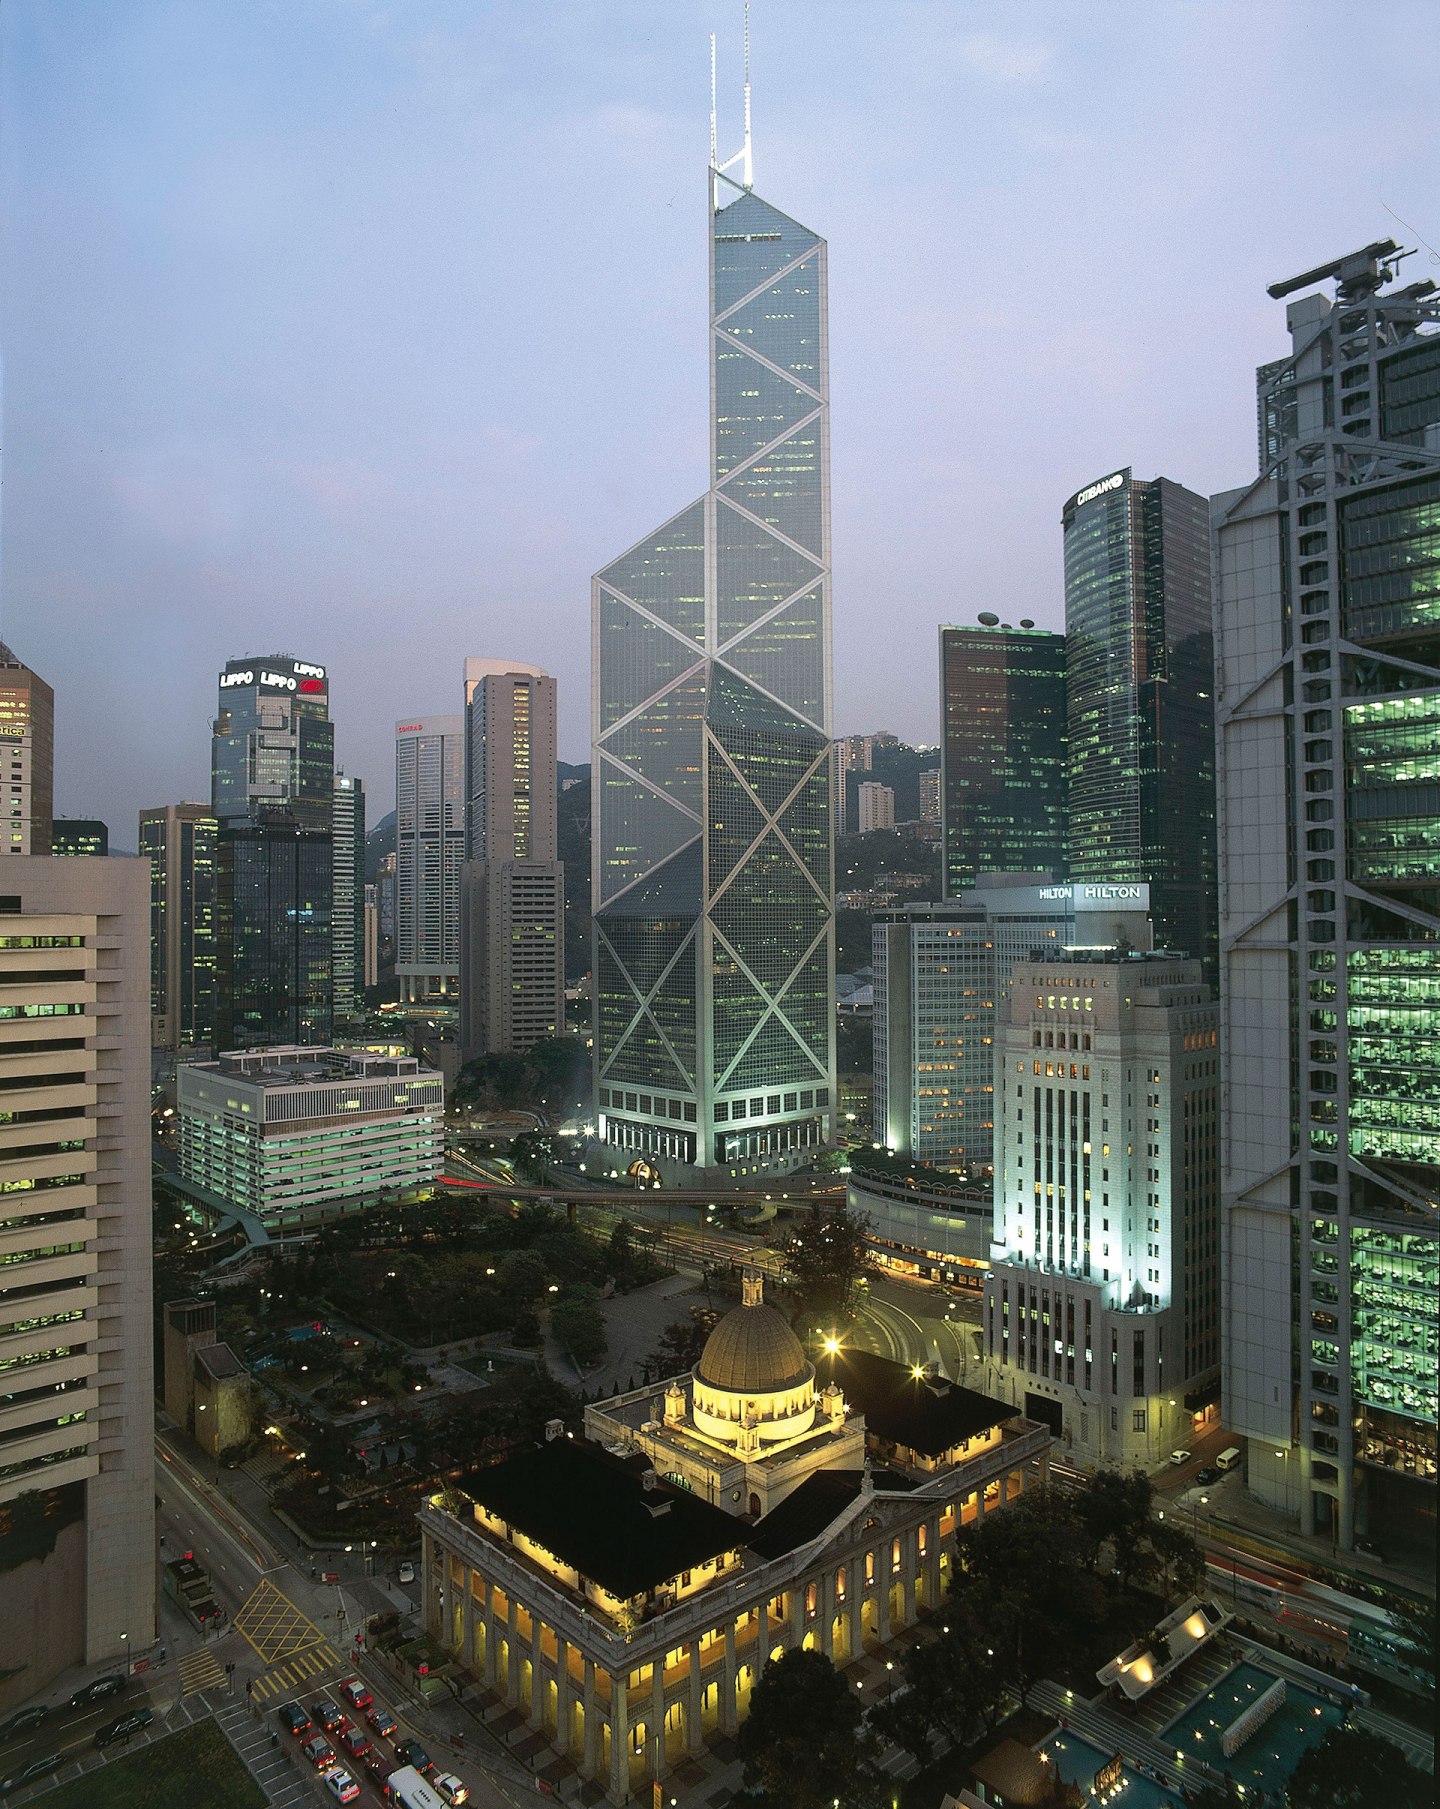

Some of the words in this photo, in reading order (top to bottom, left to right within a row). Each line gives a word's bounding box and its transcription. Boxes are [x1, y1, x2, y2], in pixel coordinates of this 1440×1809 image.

[1077, 477, 1113, 506] CITIBANK
[294, 662, 325, 679] LIPPO
[220, 671, 254, 688] LIPPO
[260, 671, 297, 691] LIPPO
[1040, 887, 1073, 900] HILTON
[1085, 887, 1141, 899] HILTON
